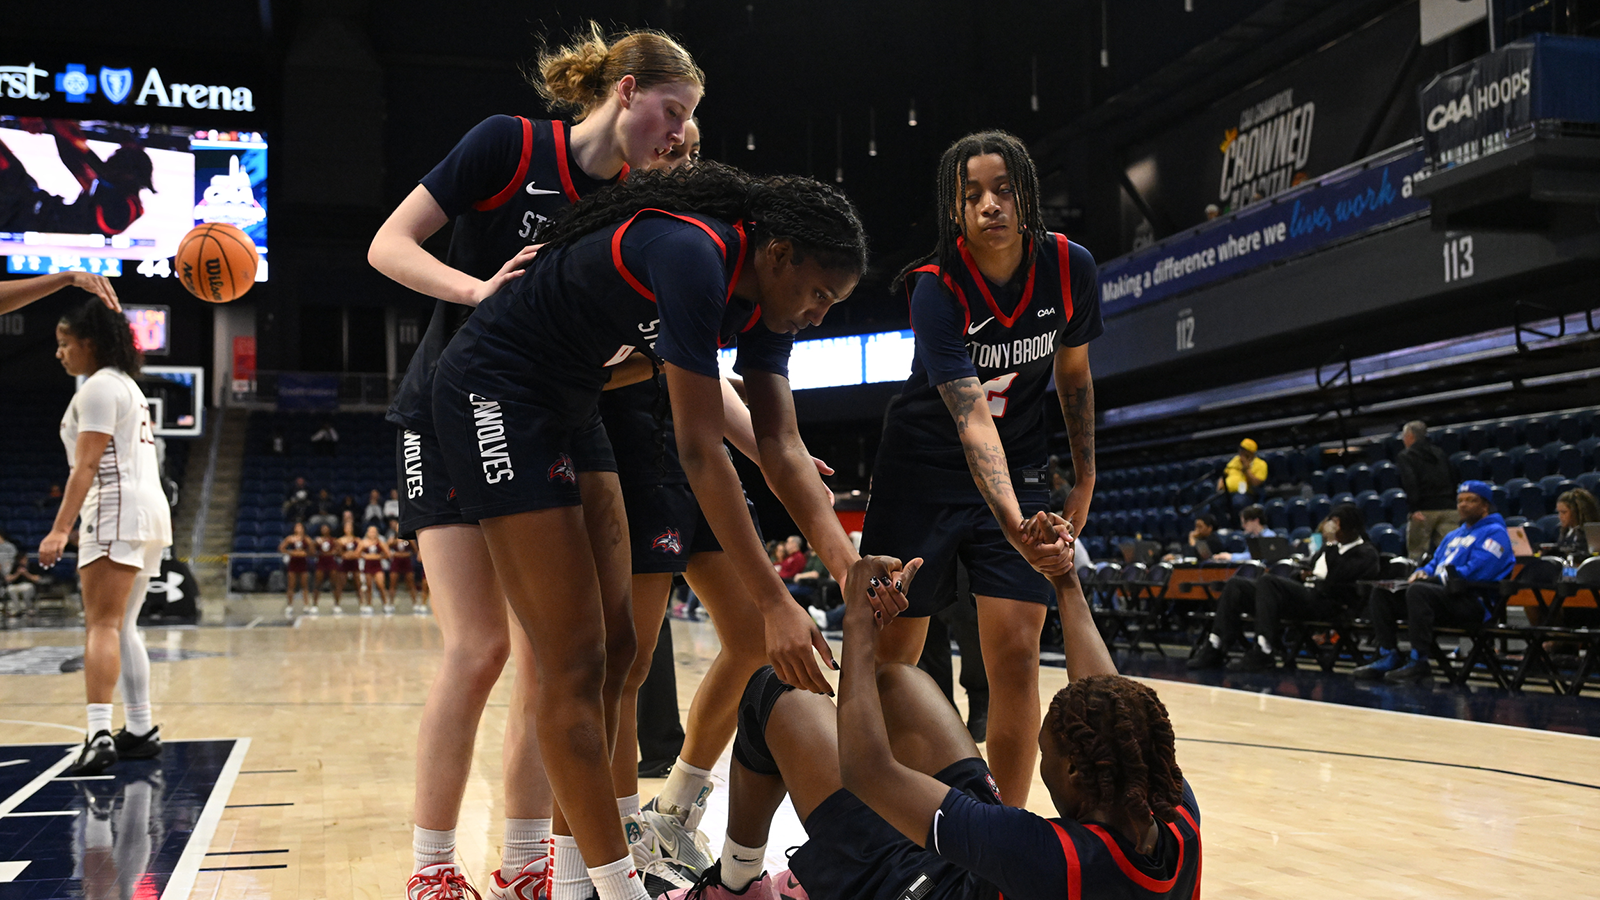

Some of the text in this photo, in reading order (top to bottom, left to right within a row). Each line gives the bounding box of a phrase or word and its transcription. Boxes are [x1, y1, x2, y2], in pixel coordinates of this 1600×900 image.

[134, 67, 255, 112] Arena
[1426, 67, 1531, 132] CAA HOOPS
[1219, 101, 1315, 202] CROWNED
[1102, 273, 1143, 303] Making
[1143, 270, 1152, 288] a
[1153, 247, 1216, 286] difference
[1217, 234, 1261, 263] where
[1263, 222, 1286, 246] we
[1334, 166, 1397, 223] work
[1442, 235, 1474, 283] 113
[1037, 307, 1056, 318] CAA
[1175, 316, 1195, 351] 112
[965, 329, 1057, 369] TONY BROOK
[403, 429, 424, 500] WOLVES
